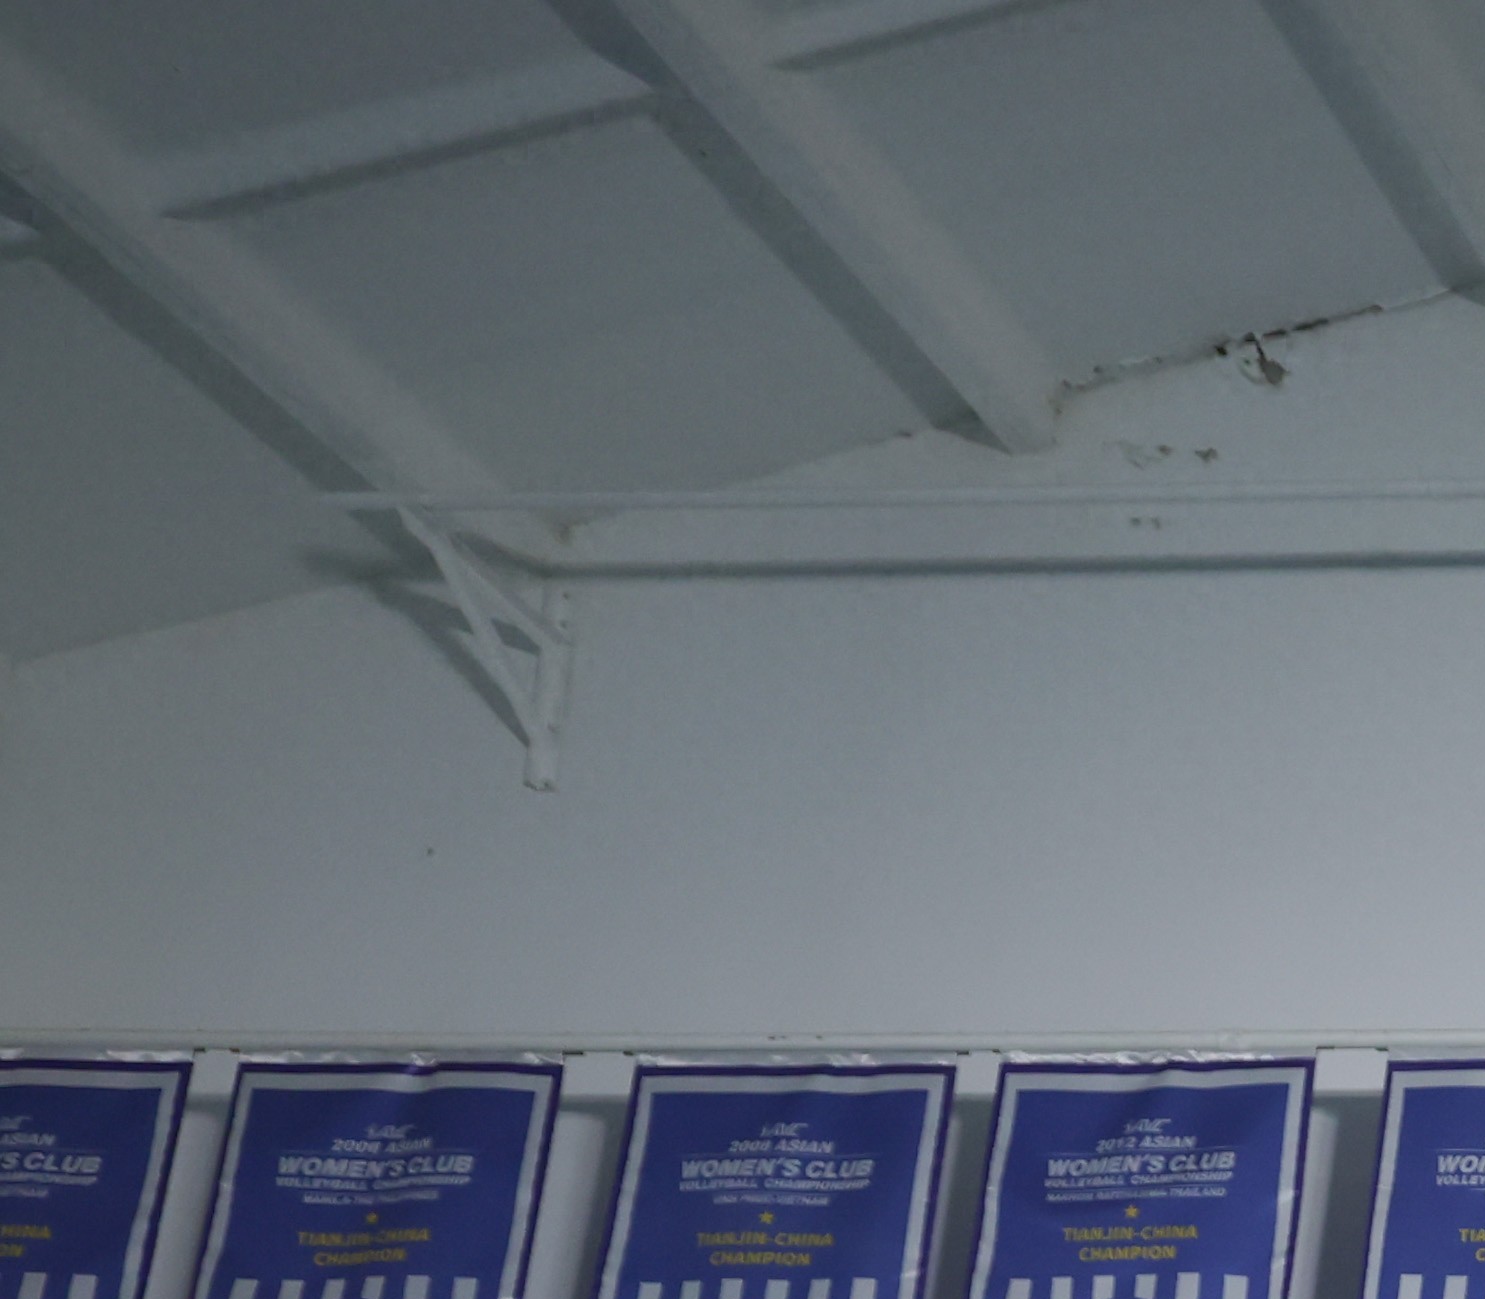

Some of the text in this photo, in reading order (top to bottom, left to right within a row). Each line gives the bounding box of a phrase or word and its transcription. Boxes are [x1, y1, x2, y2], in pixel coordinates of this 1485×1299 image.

[774, 1138, 835, 1153] ASIAN
[1139, 1135, 1197, 1149] ASIAN
[278, 1154, 475, 1178] WOMEN'S CLUB
[681, 1157, 876, 1179] WOMEN'S CLUB
[1047, 1151, 1236, 1177] WOMEN'S CLUB
[1130, 1170, 1234, 1185] CHAMPIONSHIP
[697, 1231, 835, 1247] TIANJIN-CHINA
[1062, 1224, 1199, 1241] TIANJIN-CHINA
[709, 1251, 811, 1266] CHAMPION
[1078, 1245, 1177, 1261] CHAMPION
